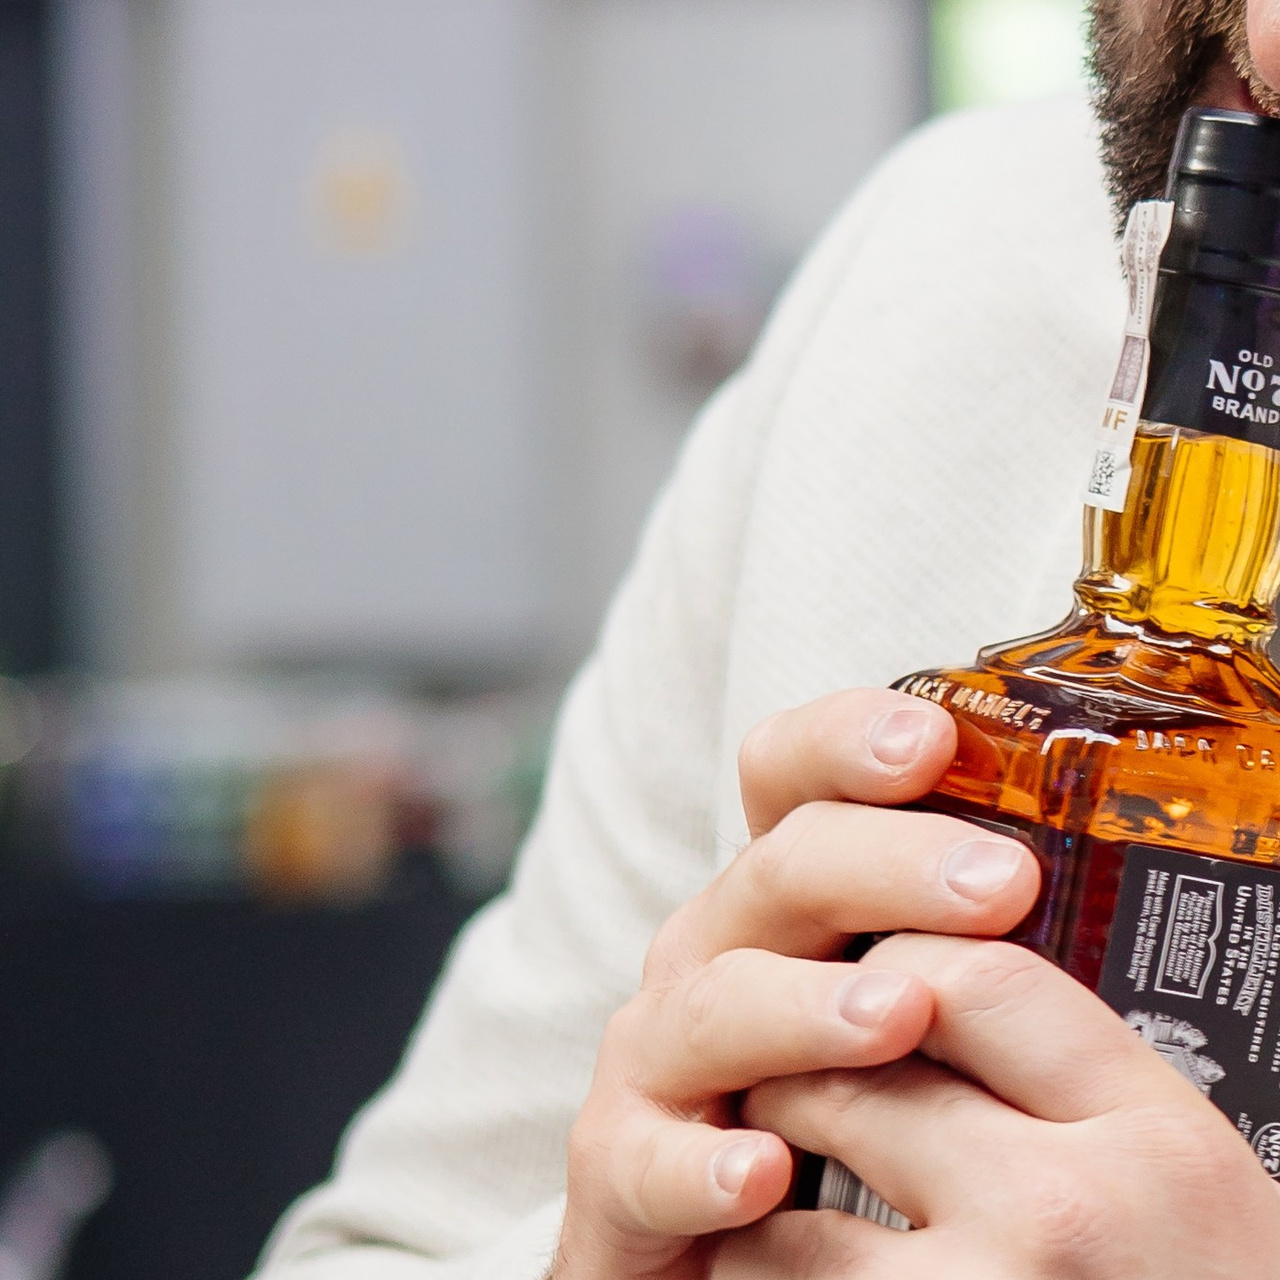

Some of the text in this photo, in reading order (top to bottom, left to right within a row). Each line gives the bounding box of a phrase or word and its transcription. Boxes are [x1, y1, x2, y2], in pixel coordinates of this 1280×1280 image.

[1238, 349, 1273, 368] OLD
[1212, 395, 1280, 425] BRAND
[1155, 872, 1170, 896] Made
[1152, 897, 1163, 915] with
[1147, 916, 1161, 938] Cave
[1140, 939, 1156, 967] Spring
[1216, 886, 1252, 1005] UNITED STATES
[1234, 885, 1274, 1016] DISTILLERY
[1237, 926, 1254, 970] IN THE
